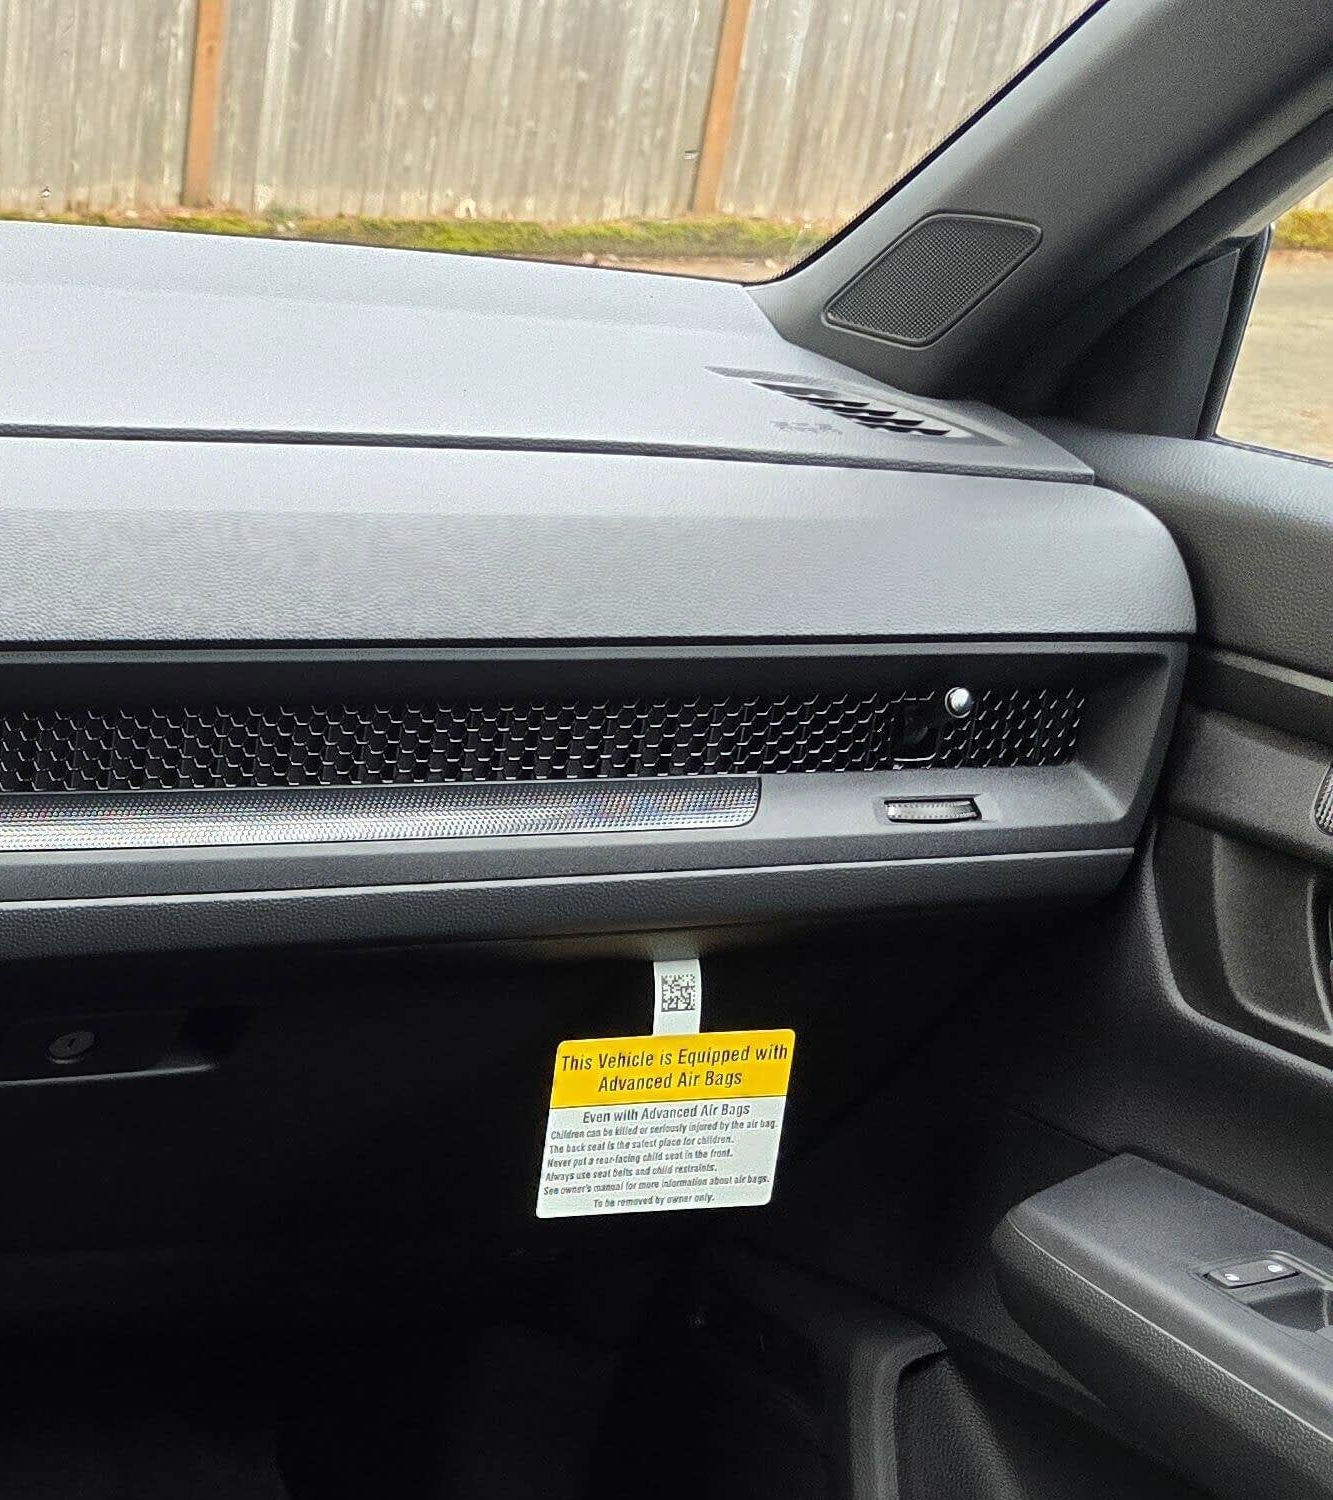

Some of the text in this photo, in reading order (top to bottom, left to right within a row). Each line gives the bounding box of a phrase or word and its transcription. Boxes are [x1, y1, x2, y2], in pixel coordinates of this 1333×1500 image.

[562, 1044, 787, 1071] This Vehicle is Equipped with
[598, 1070, 742, 1092] Advanced Air Bags
[583, 1103, 750, 1123] Even with Advanced Air Bags
[551, 1129, 584, 1140] Children
